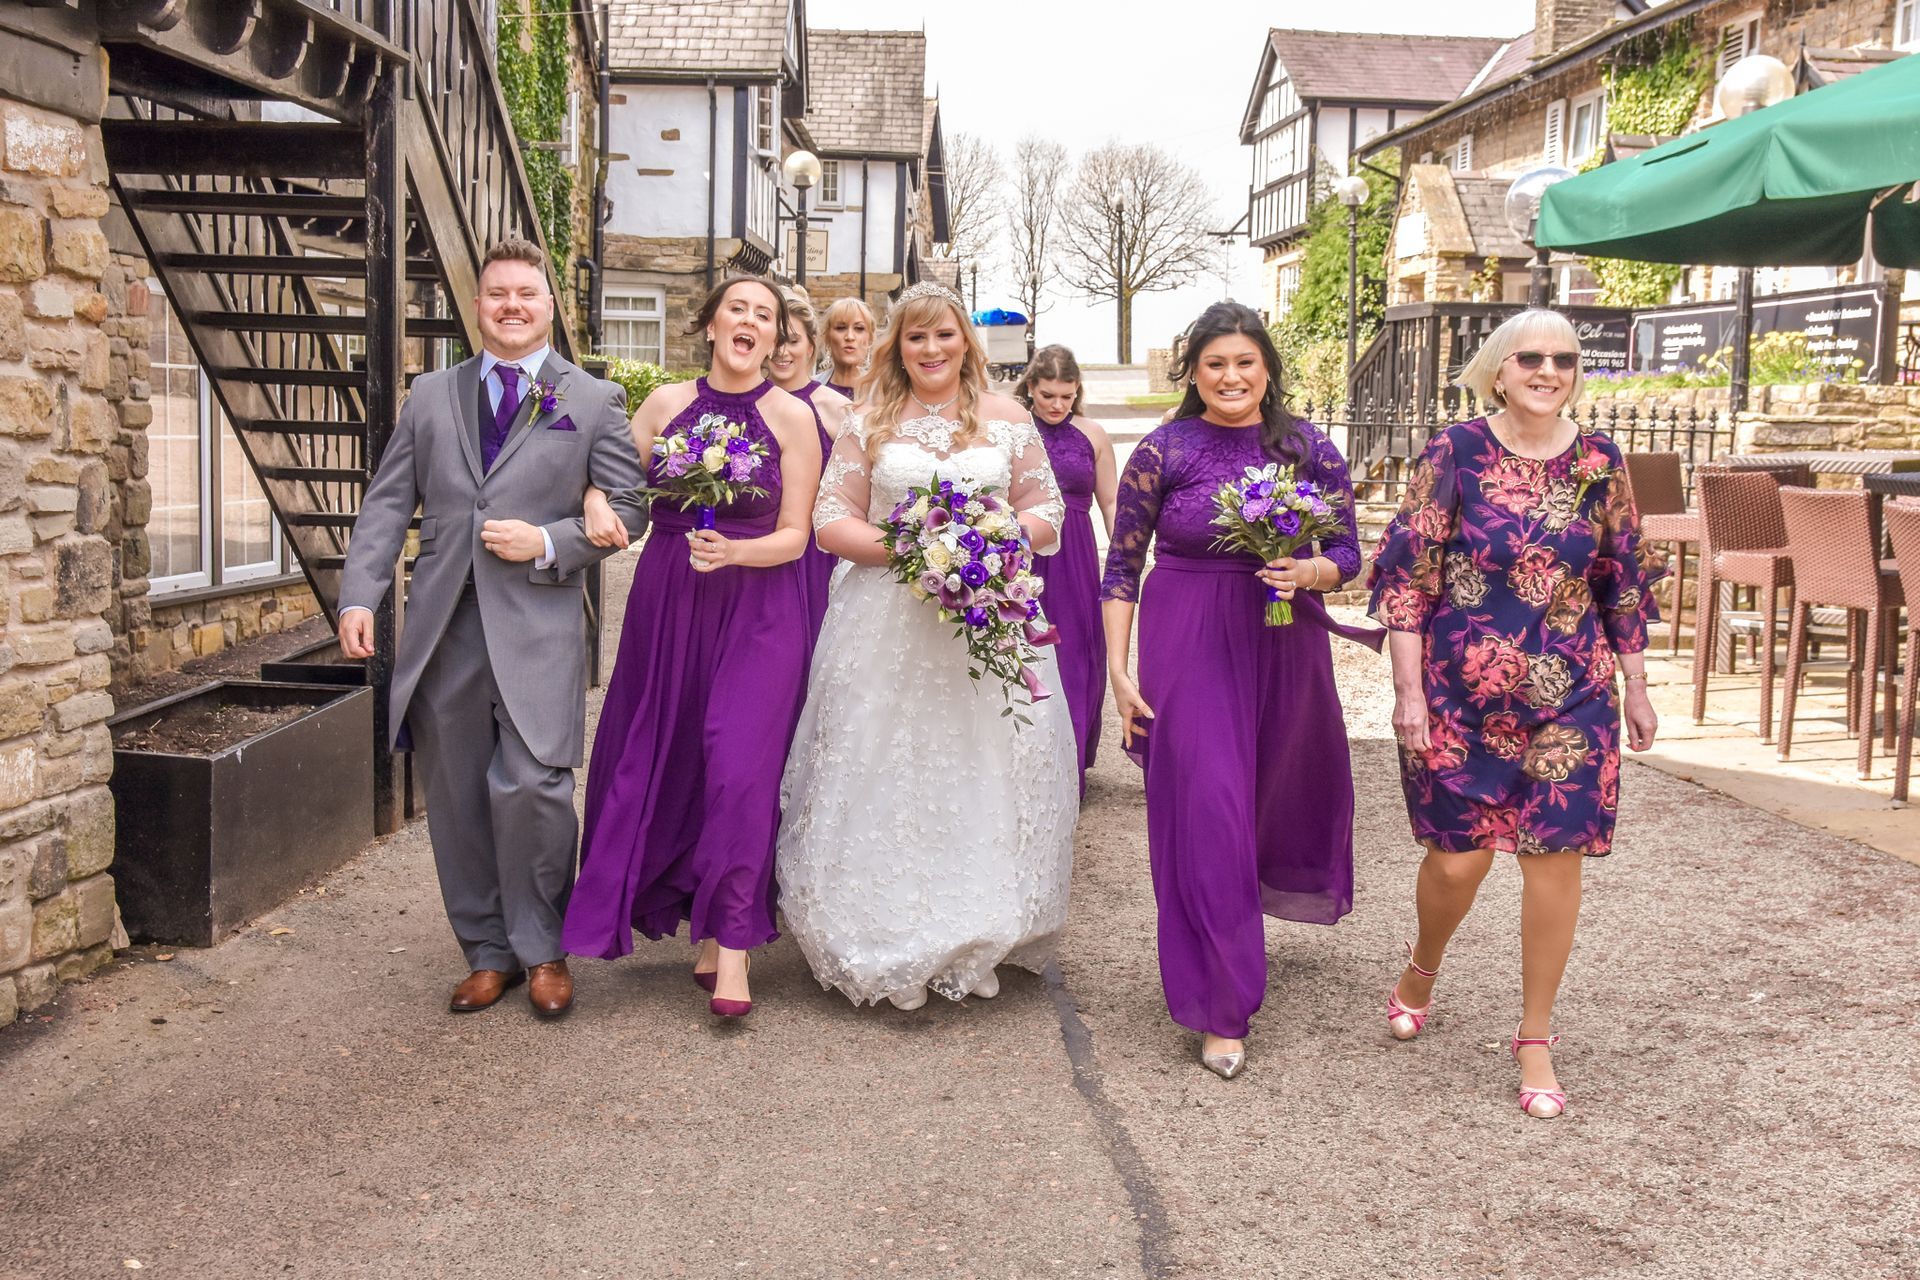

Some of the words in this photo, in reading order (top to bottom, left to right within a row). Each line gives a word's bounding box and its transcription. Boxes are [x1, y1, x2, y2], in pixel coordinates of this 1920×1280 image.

[1591, 350, 1626, 358] Occasions
[1598, 359, 1610, 367] 591
[1611, 359, 1625, 368] 965
